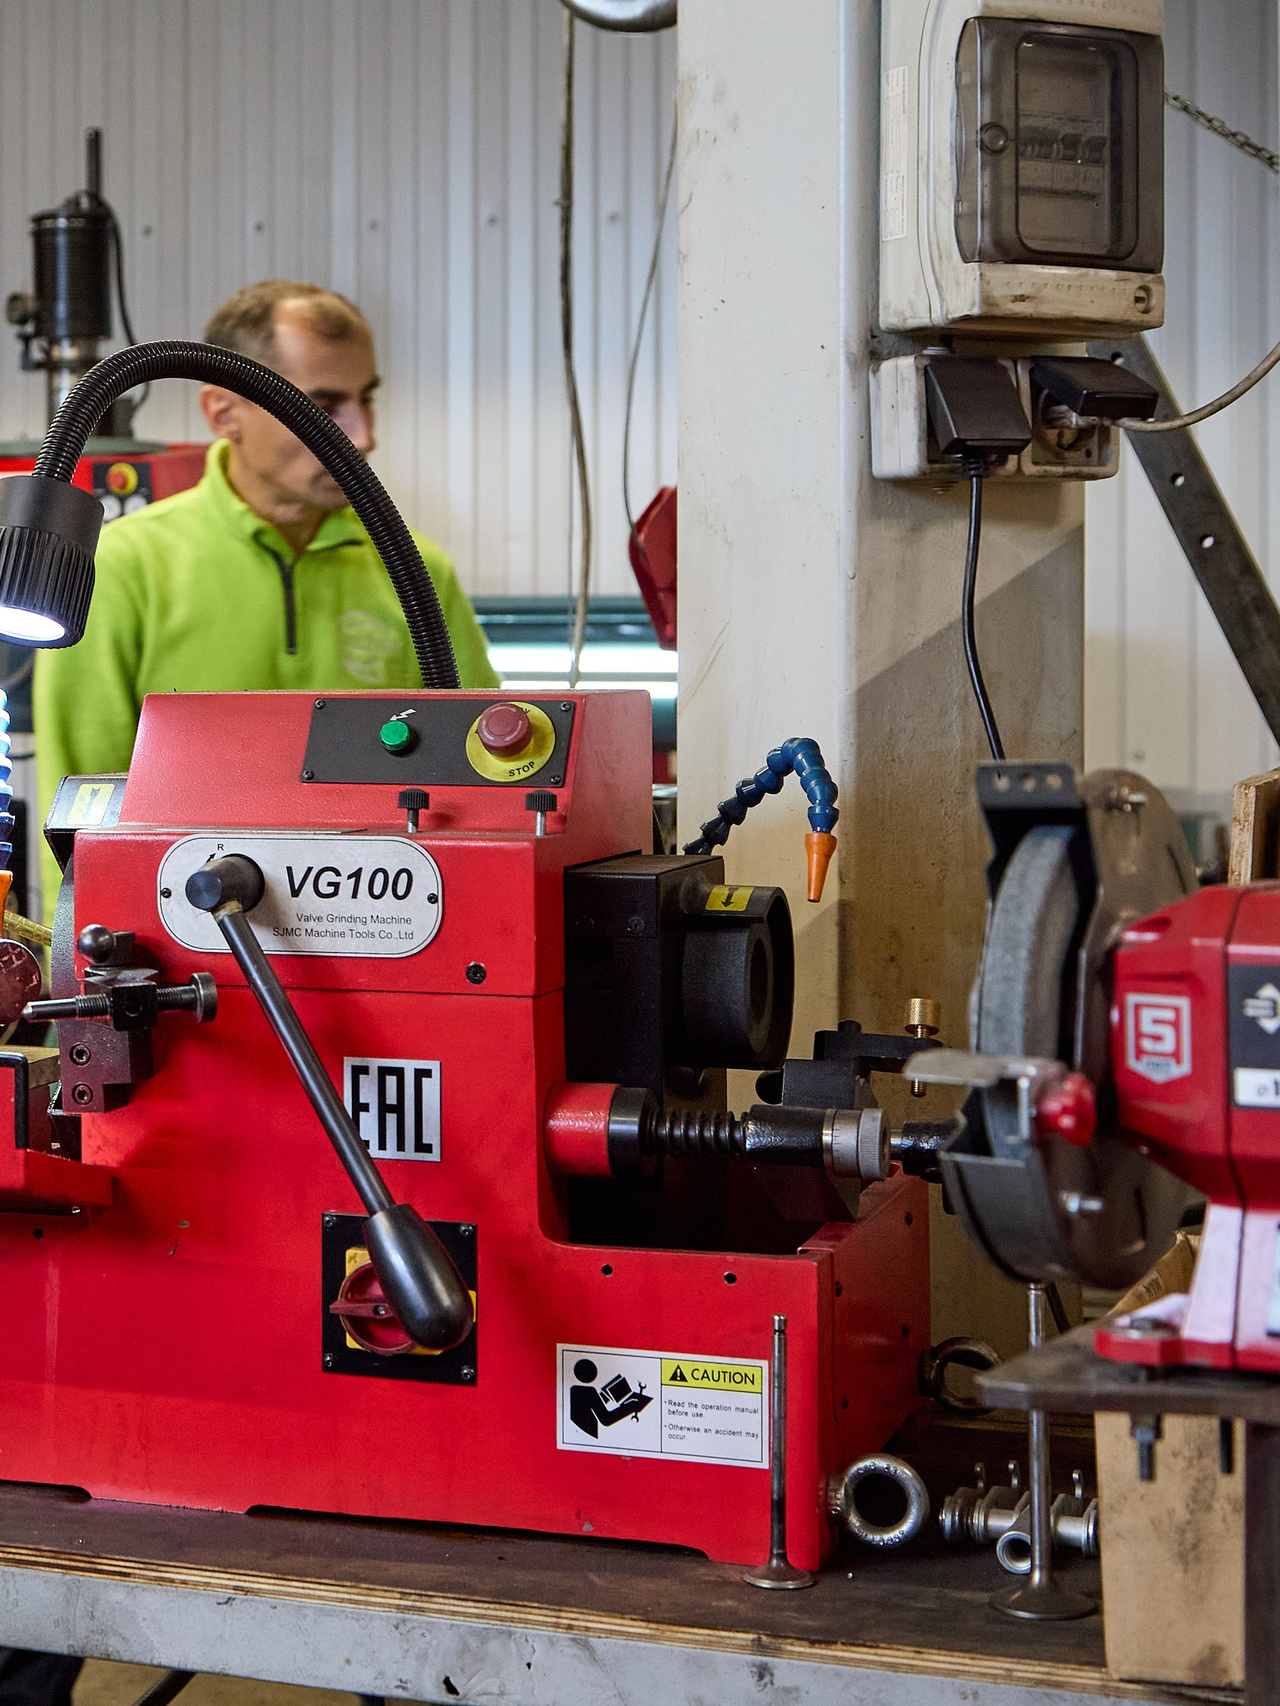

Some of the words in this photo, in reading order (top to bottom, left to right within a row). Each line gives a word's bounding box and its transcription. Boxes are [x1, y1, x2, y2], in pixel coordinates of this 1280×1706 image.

[509, 761, 535, 777] STOP
[285, 866, 414, 901] VG100
[296, 913, 323, 923] Valve
[326, 914, 368, 926] Grinding
[370, 915, 412, 925] Machine
[273, 928, 302, 938] SJMC
[305, 928, 345, 938] Machine
[348, 929, 376, 939] Tools
[379, 930, 414, 940] Co.,Ltd
[1141, 1006, 1176, 1054] 5
[351, 1065, 433, 1154] EAC
[691, 1368, 755, 1386] CAUTION
[668, 1400, 685, 1409] Read
[688, 1401, 698, 1409] the
[701, 1402, 732, 1412] operation
[734, 1406, 759, 1414] manual
[668, 1408, 689, 1418] before
[668, 1424, 701, 1434] Otherwise
[715, 1427, 743, 1437] accident
[745, 1432, 759, 1440] may
